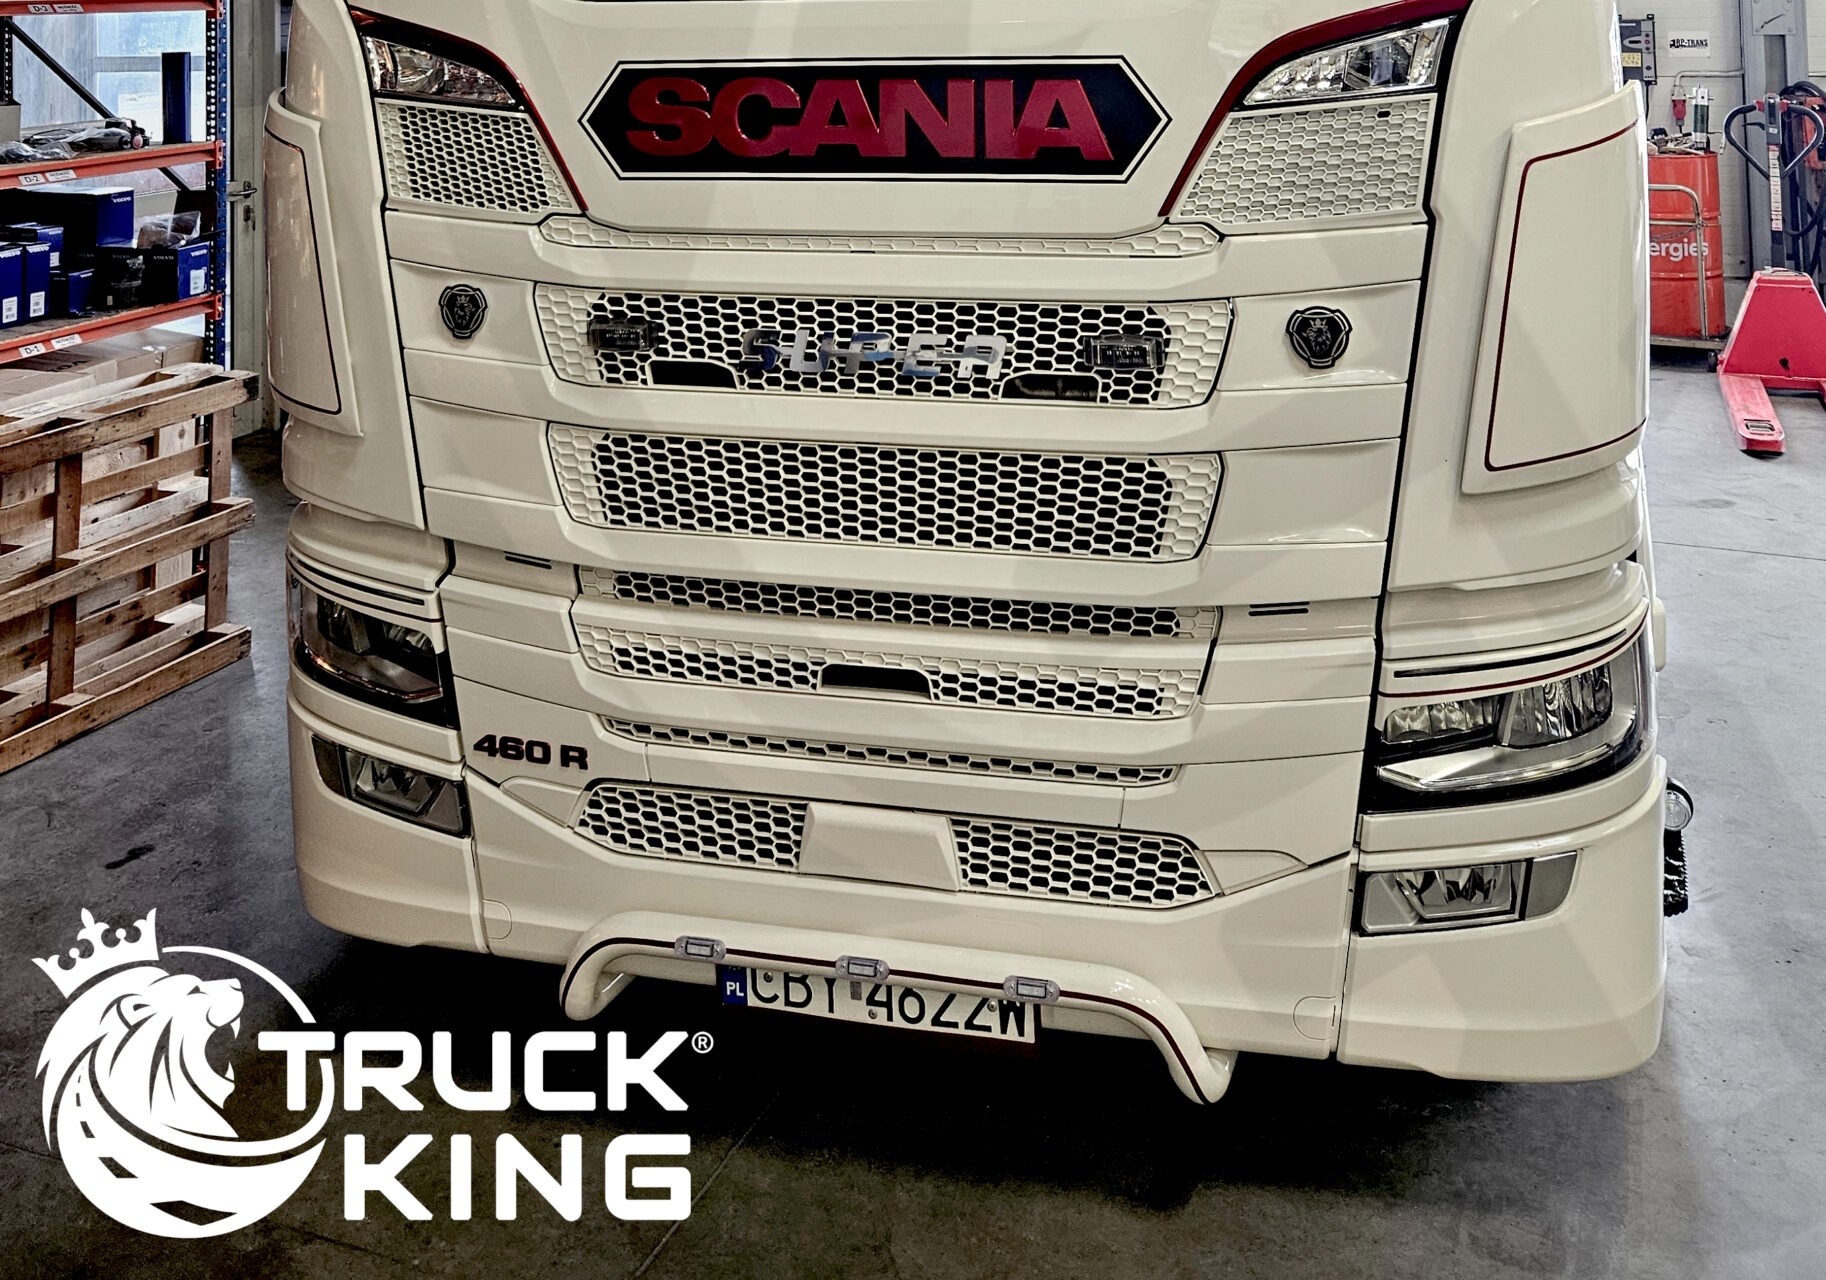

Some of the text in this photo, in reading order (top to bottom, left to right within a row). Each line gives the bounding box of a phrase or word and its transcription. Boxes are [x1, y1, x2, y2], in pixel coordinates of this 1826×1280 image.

[625, 76, 1115, 161] SCANIA
[24, 175, 40, 183] D-2
[24, 345, 40, 355] D-1
[738, 327, 1007, 380] SUPER
[472, 733, 589, 771] 460 R
[726, 981, 744, 997] PL
